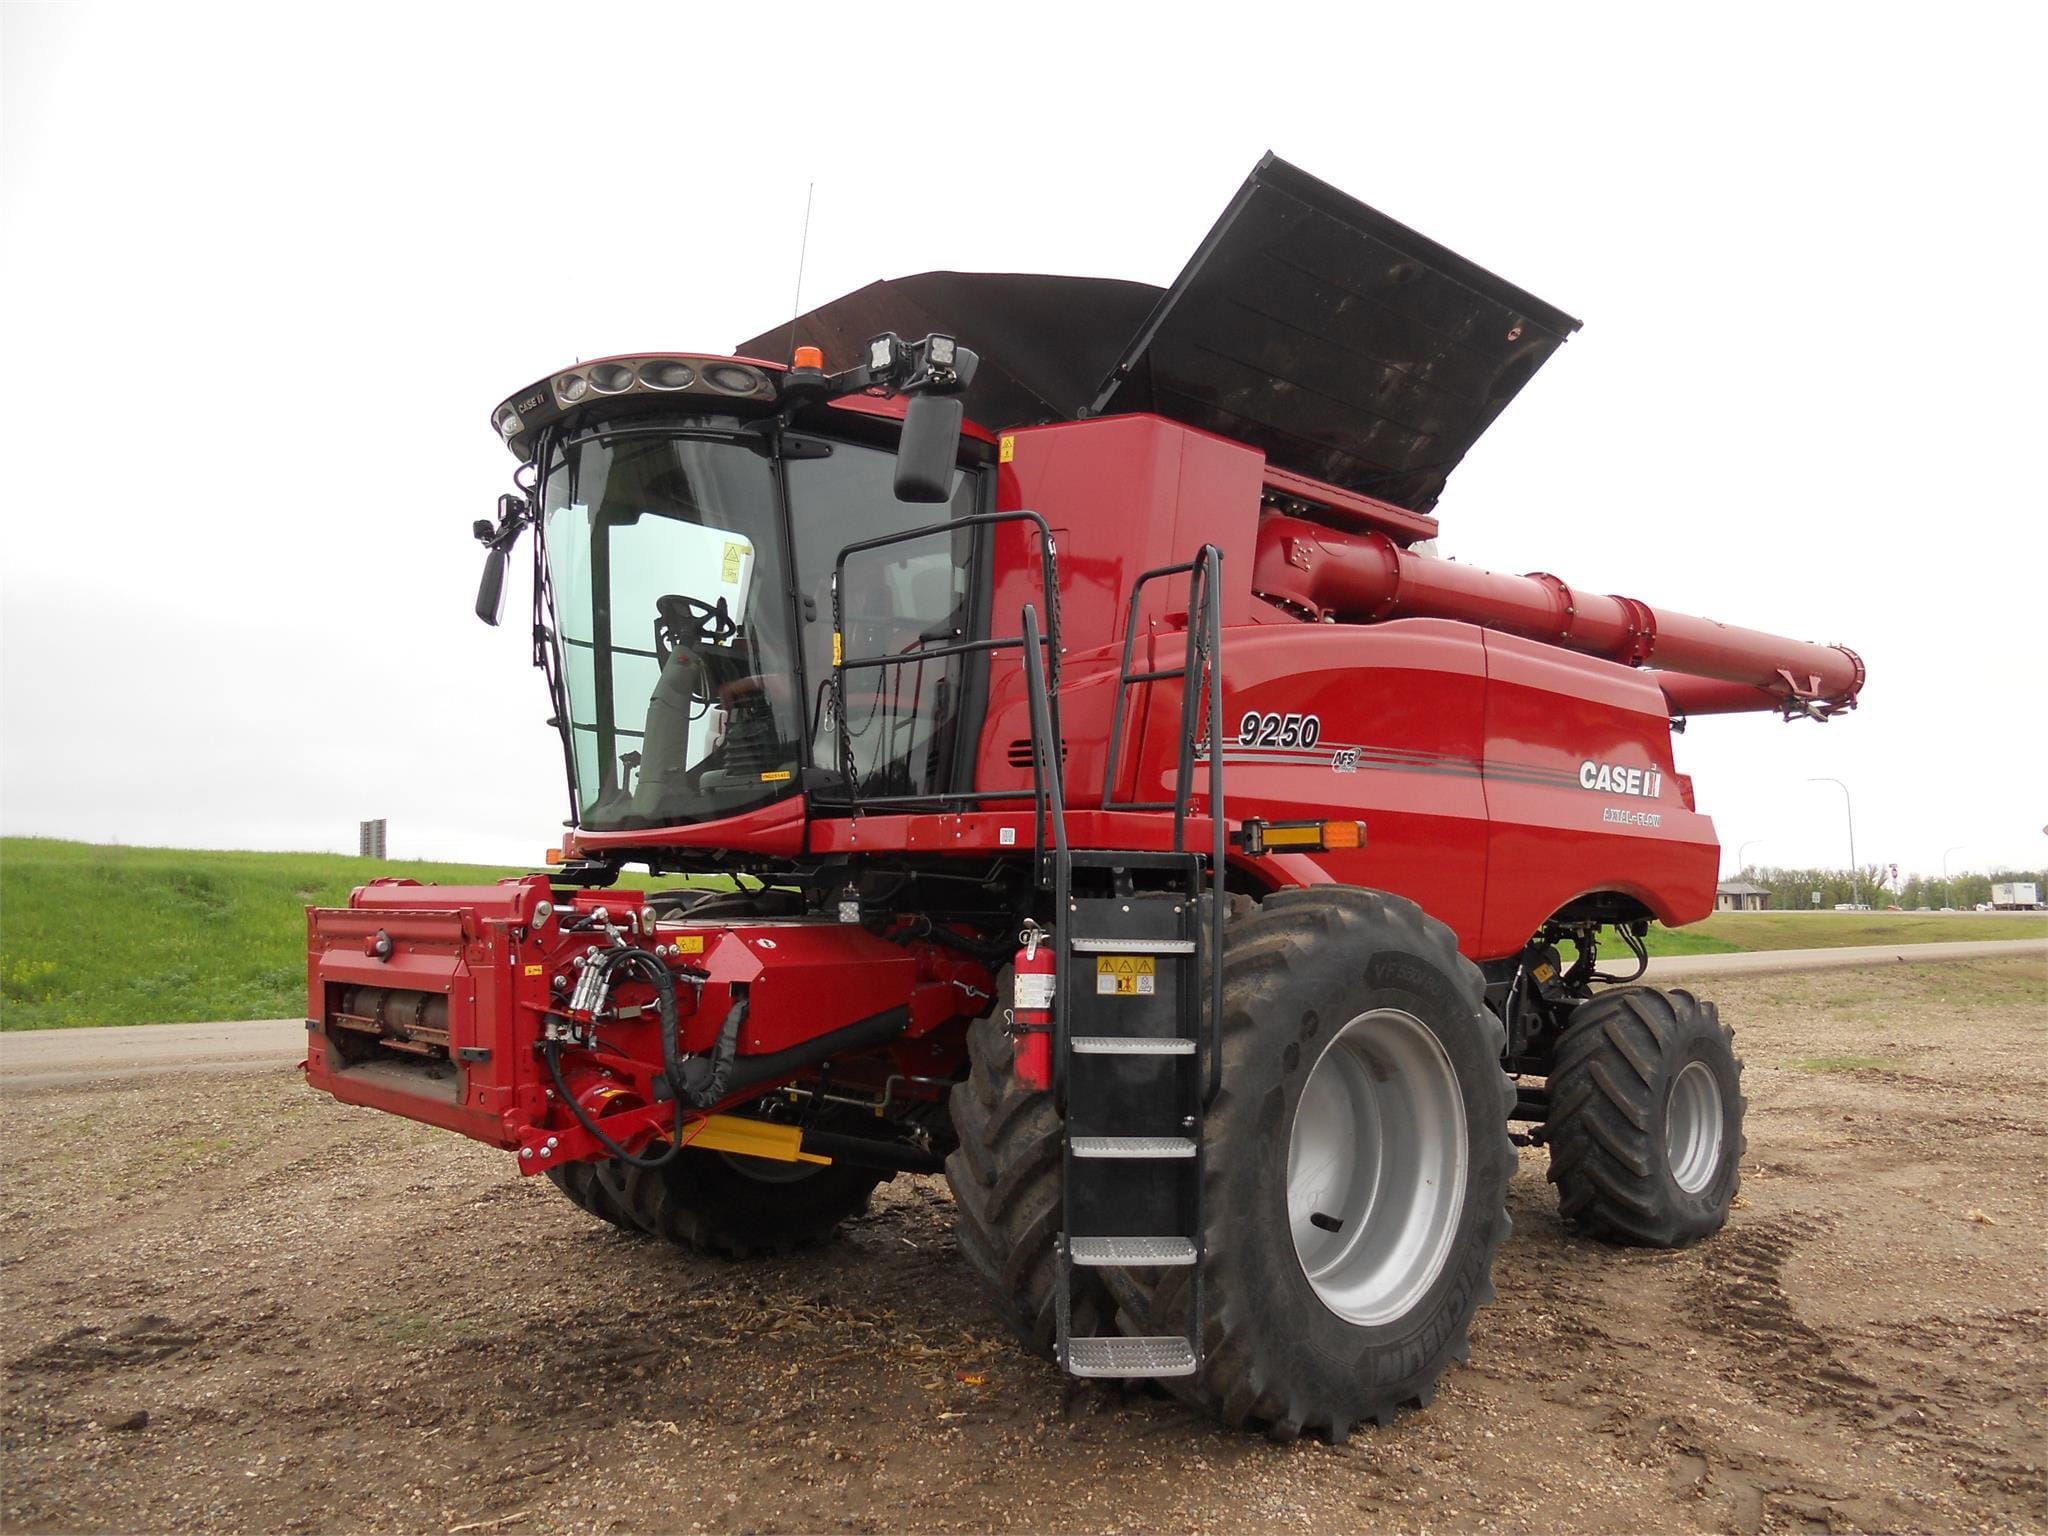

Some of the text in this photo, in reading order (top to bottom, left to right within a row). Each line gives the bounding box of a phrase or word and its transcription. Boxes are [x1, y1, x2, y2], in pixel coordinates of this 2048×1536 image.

[518, 397, 537, 414] CASE
[1239, 711, 1320, 748] 9250
[1332, 749, 1355, 767] AFS
[1579, 760, 1642, 796] CASE
[1603, 807, 1662, 828] AXIAL-FLOW
